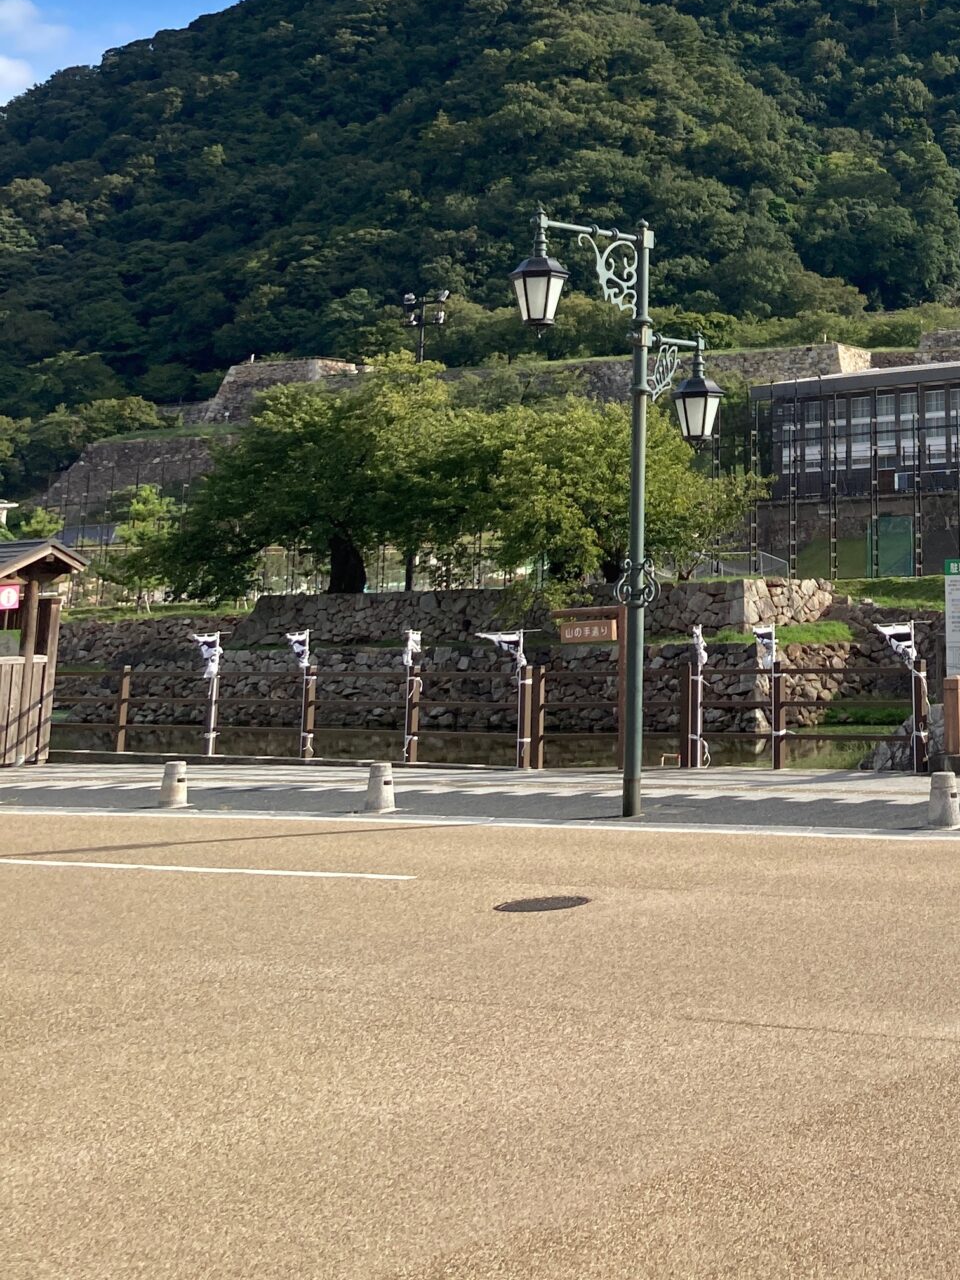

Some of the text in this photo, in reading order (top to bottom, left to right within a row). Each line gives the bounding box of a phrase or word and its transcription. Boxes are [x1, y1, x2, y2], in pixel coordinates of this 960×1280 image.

[565, 625, 608, 639] 山の手通り
